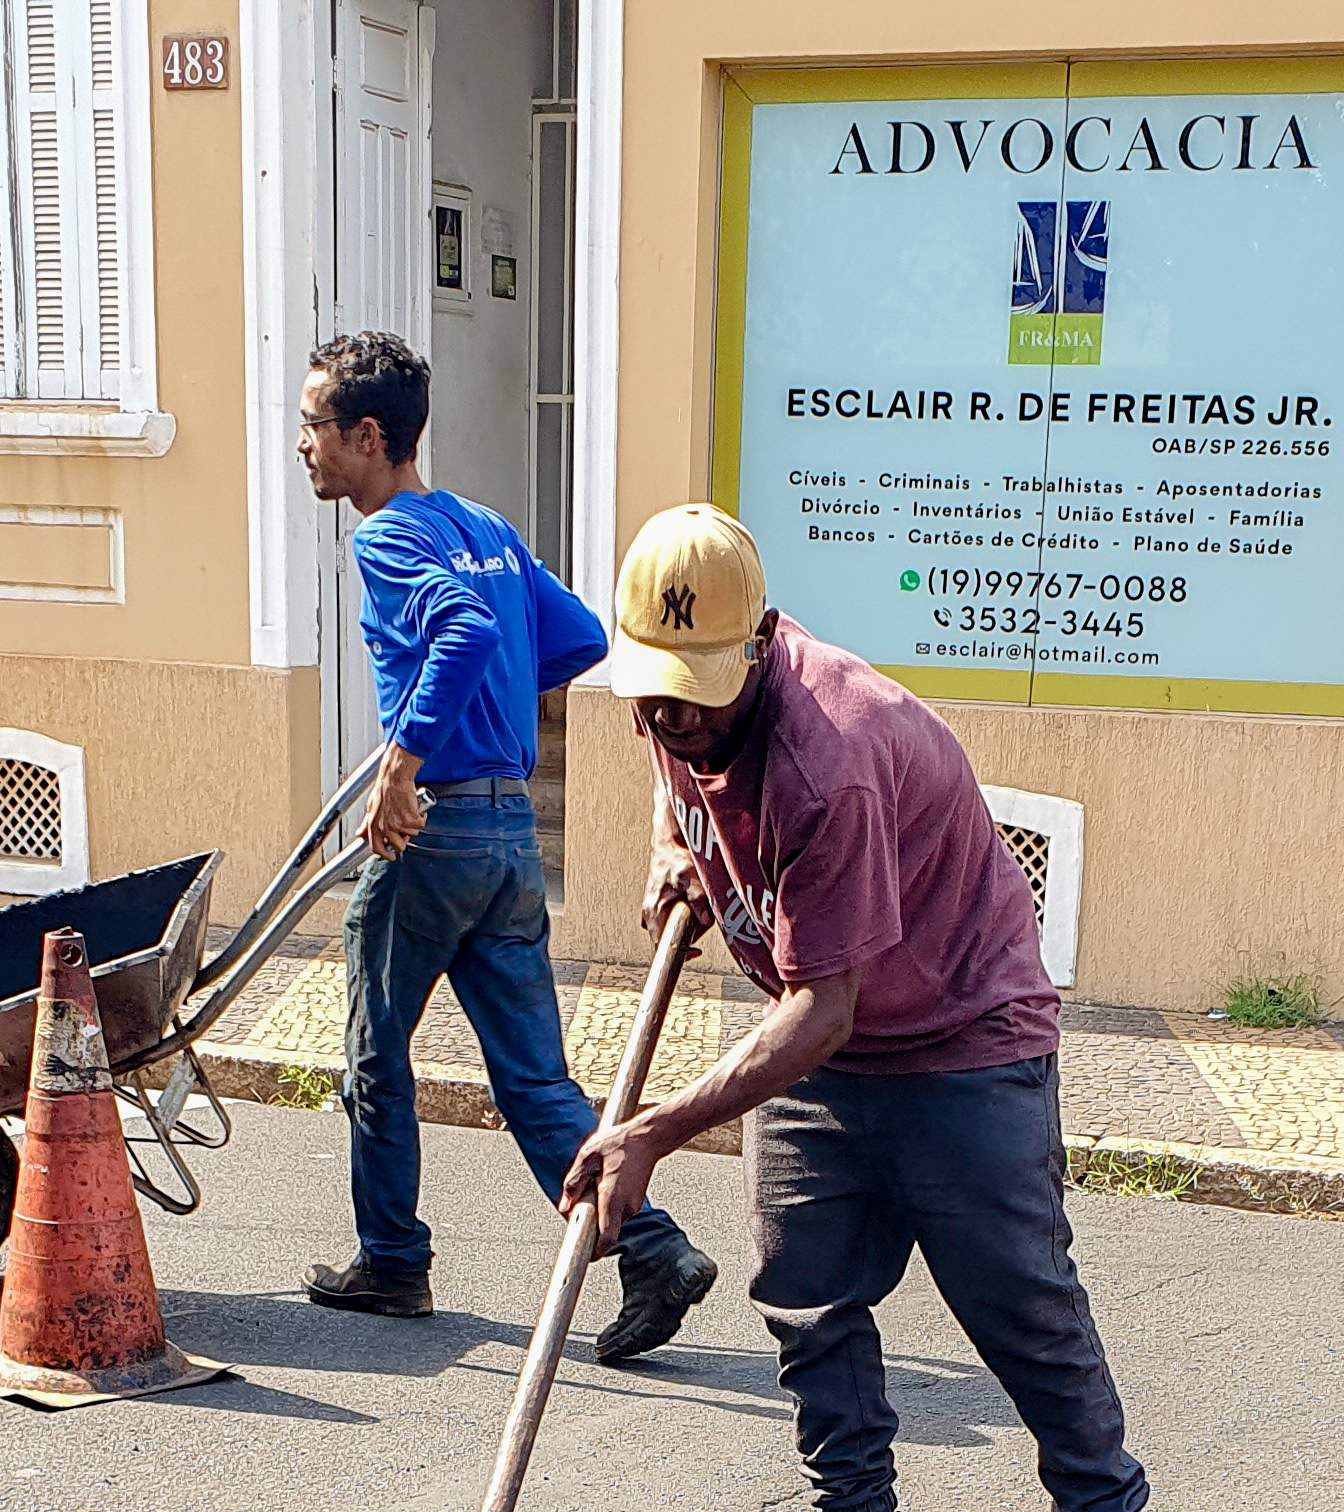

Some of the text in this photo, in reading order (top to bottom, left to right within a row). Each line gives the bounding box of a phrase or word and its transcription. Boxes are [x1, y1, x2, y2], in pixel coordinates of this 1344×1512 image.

[164, 40, 224, 85] 483
[829, 114, 1320, 175] ADVOCACIA
[1019, 330, 1094, 347] FR&MA
[787, 388, 1332, 426] ESCLAIR R. DE FREITAS JR.
[1152, 438, 1330, 456] OAB/SP 226.556
[789, 470, 846, 486] Cíveis
[879, 472, 970, 490] Criminais
[1002, 475, 1123, 494] Trabalhistas
[1156, 480, 1322, 499] Aposentadorias
[801, 498, 880, 515] Divórcio
[913, 501, 1022, 519] Inventários
[1058, 505, 1113, 522] União
[1122, 508, 1194, 524] Estável
[1230, 510, 1304, 527] Família
[809, 526, 875, 542] Bancos
[908, 529, 984, 546] Cartões
[991, 531, 1014, 546] de
[1022, 532, 1100, 550] Crédito
[1133, 536, 1189, 552] Plano
[1197, 537, 1221, 552] de
[1229, 537, 1293, 555] Saúde
[928, 567, 1187, 602] (19)99767-0088
[660, 583, 696, 630] NY
[959, 606, 1144, 638] 3532-3445
[937, 641, 1159, 665] esclair@hotmail.com
